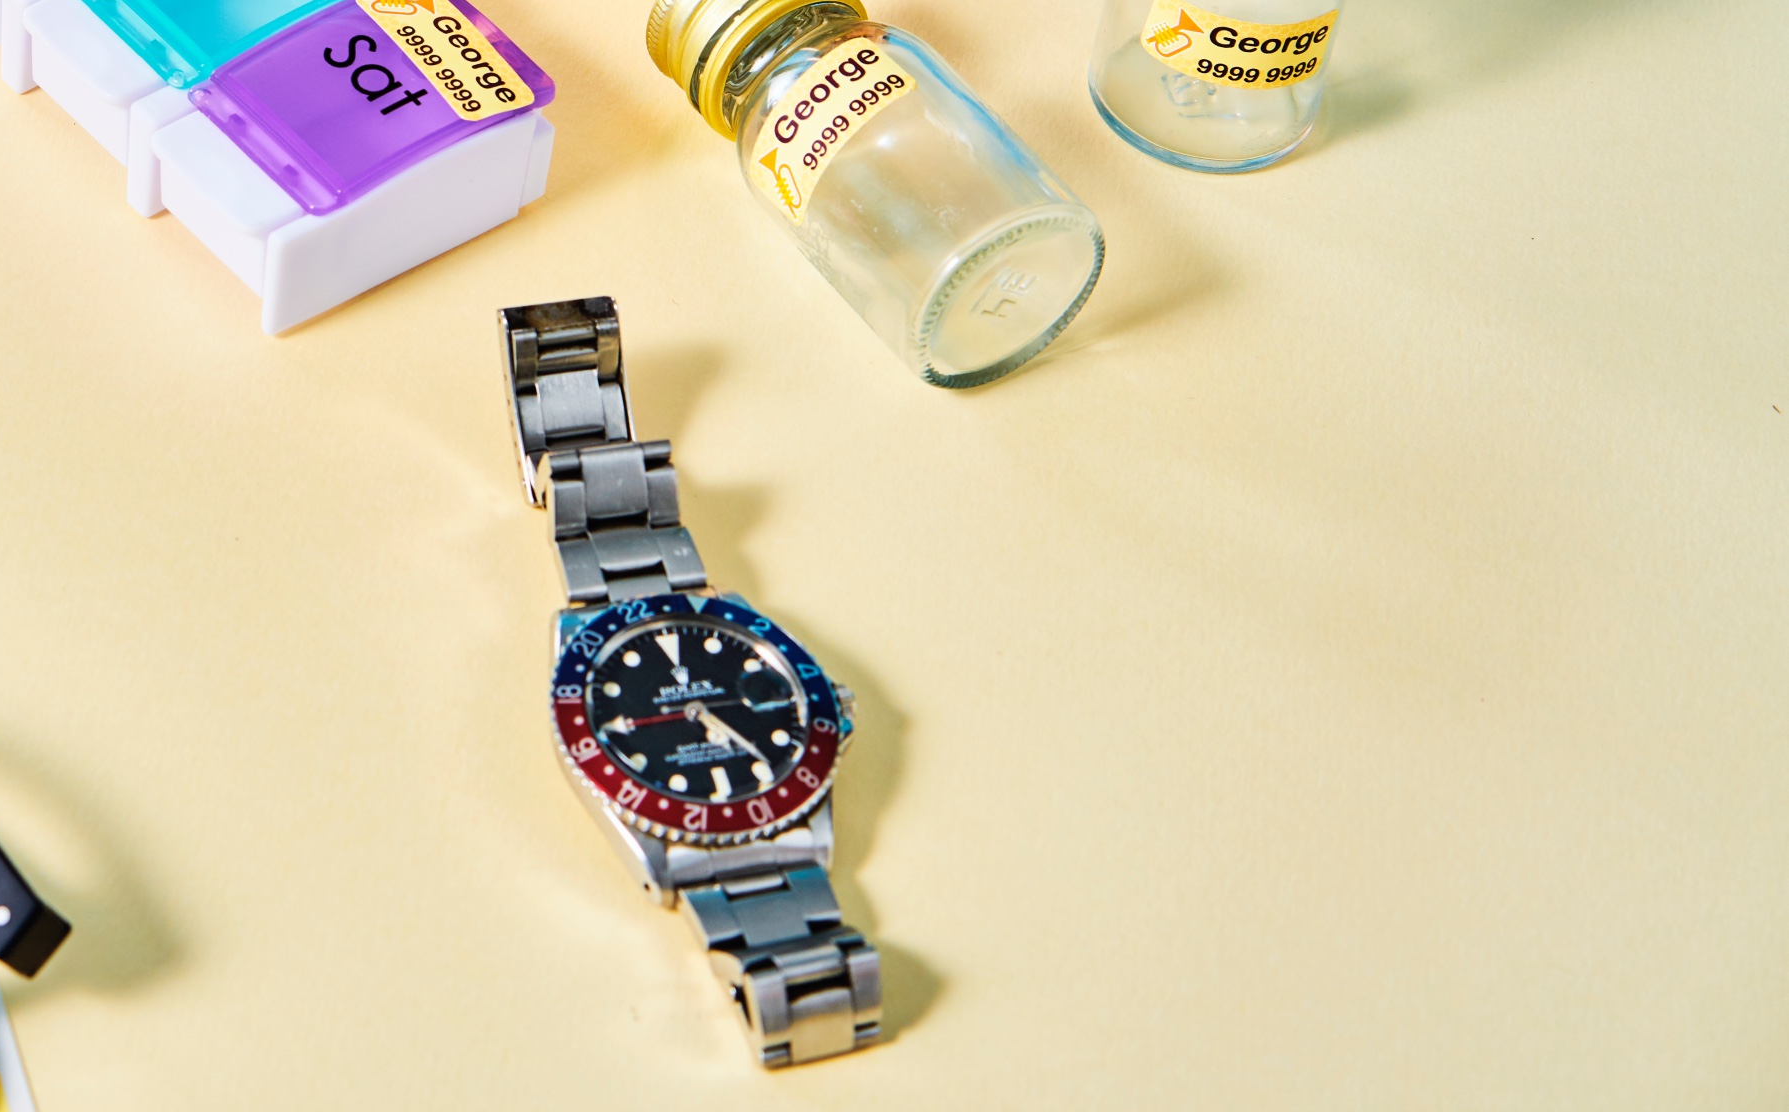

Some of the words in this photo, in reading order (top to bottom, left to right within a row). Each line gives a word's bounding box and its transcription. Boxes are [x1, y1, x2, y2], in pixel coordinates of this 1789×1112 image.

[1209, 26, 1328, 55] George
[396, 25, 441, 68] 9999
[435, 67, 482, 113] 9999
[433, 16, 516, 105] George
[1197, 59, 1260, 83] 9999
[1265, 57, 1317, 83] 9999
[323, 34, 428, 116] Sat
[774, 45, 880, 145] George
[802, 115, 850, 170] 9999
[849, 73, 906, 119] 9999
[617, 600, 654, 623] 22
[748, 618, 771, 638] 2
[572, 630, 604, 659] 20
[797, 663, 820, 680] 4
[556, 684, 583, 704] 18
[813, 717, 838, 734] 6
[570, 737, 601, 763] 16
[795, 767, 821, 790] 8
[616, 779, 648, 809] 14
[683, 803, 708, 831] 12
[747, 797, 774, 825] 10
